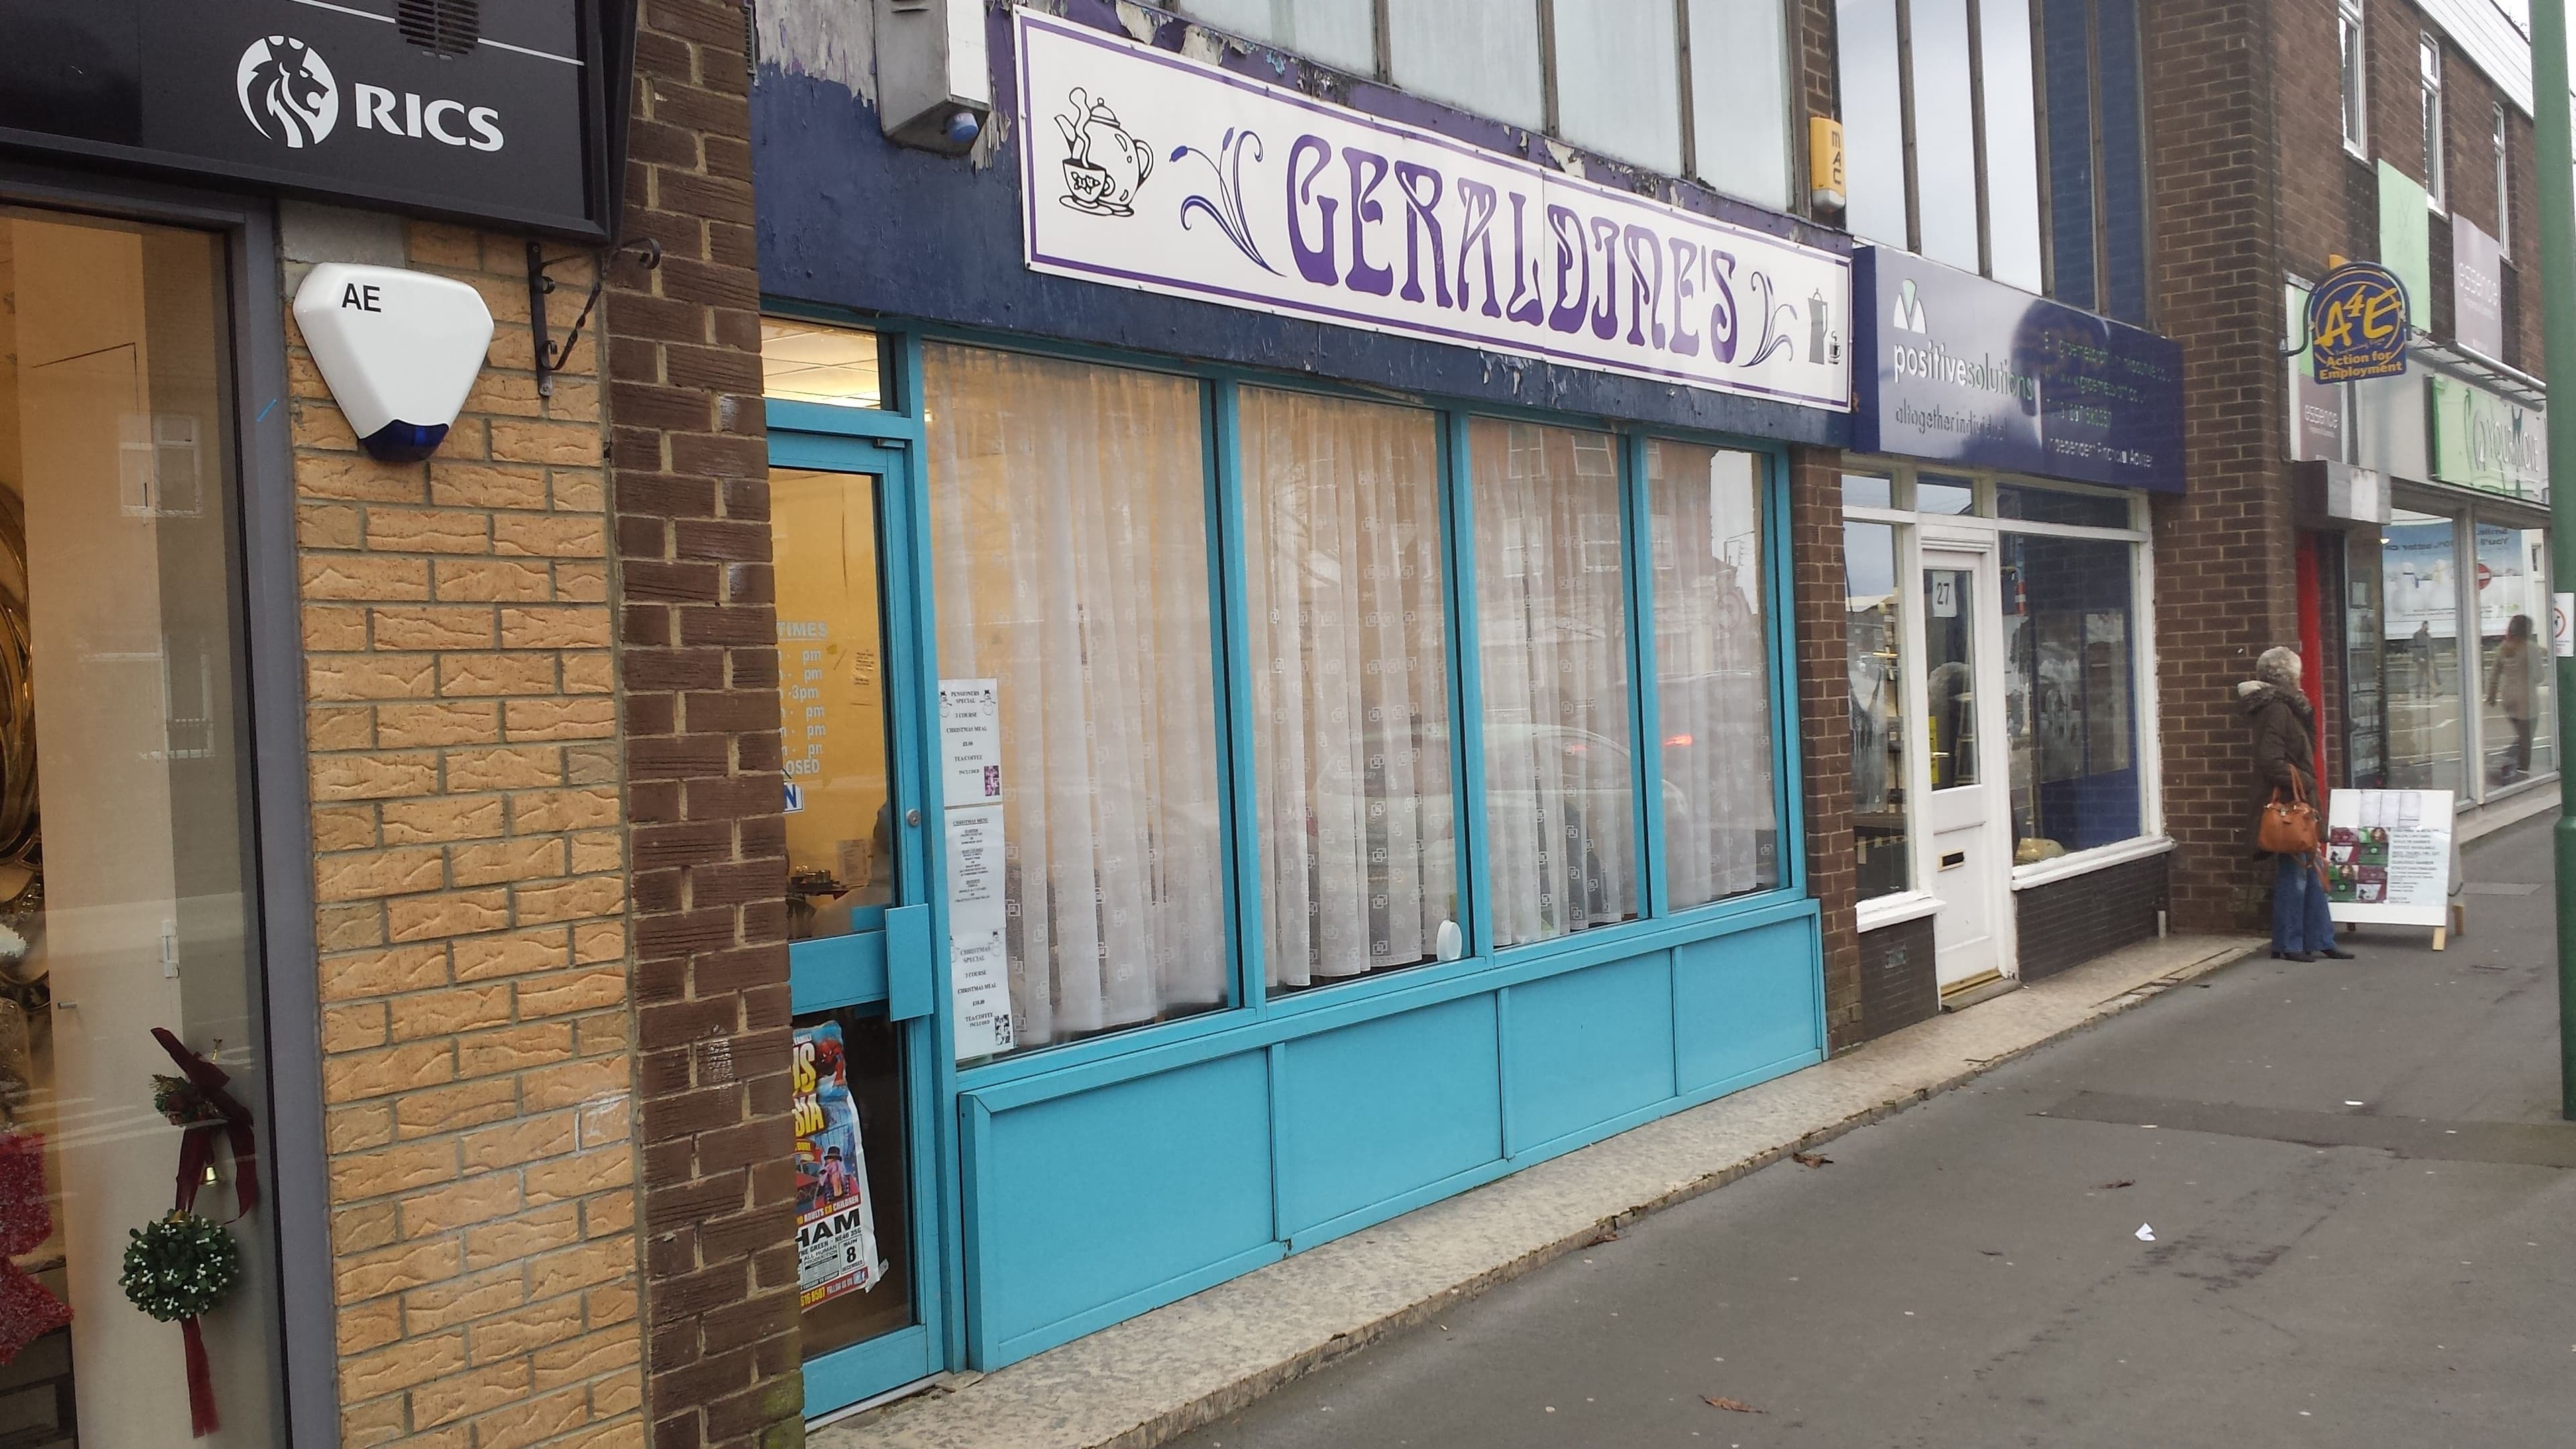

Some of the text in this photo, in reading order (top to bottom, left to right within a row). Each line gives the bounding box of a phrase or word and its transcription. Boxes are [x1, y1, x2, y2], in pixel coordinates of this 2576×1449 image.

[355, 83, 504, 152] RICS
[1286, 133, 1738, 367] GERALDINE'S
[341, 282, 382, 313] AE
[2313, 284, 2402, 347] A4E
[2326, 350, 2393, 367] Action for
[2319, 361, 2403, 380] Employment
[1937, 582, 1949, 606] 27
[776, 621, 827, 637] TIMES
[784, 758, 820, 775] OSED
[960, 946, 991, 956] CHRISTMAS
[957, 982, 997, 994] CHRISTMAS MEAL
[795, 1208, 861, 1248] HAM
[810, 1240, 828, 1253] GREEN
[816, 1244, 837, 1256] HUMAN
[843, 1238, 858, 1247] SUN
[846, 1246, 857, 1264] 8
